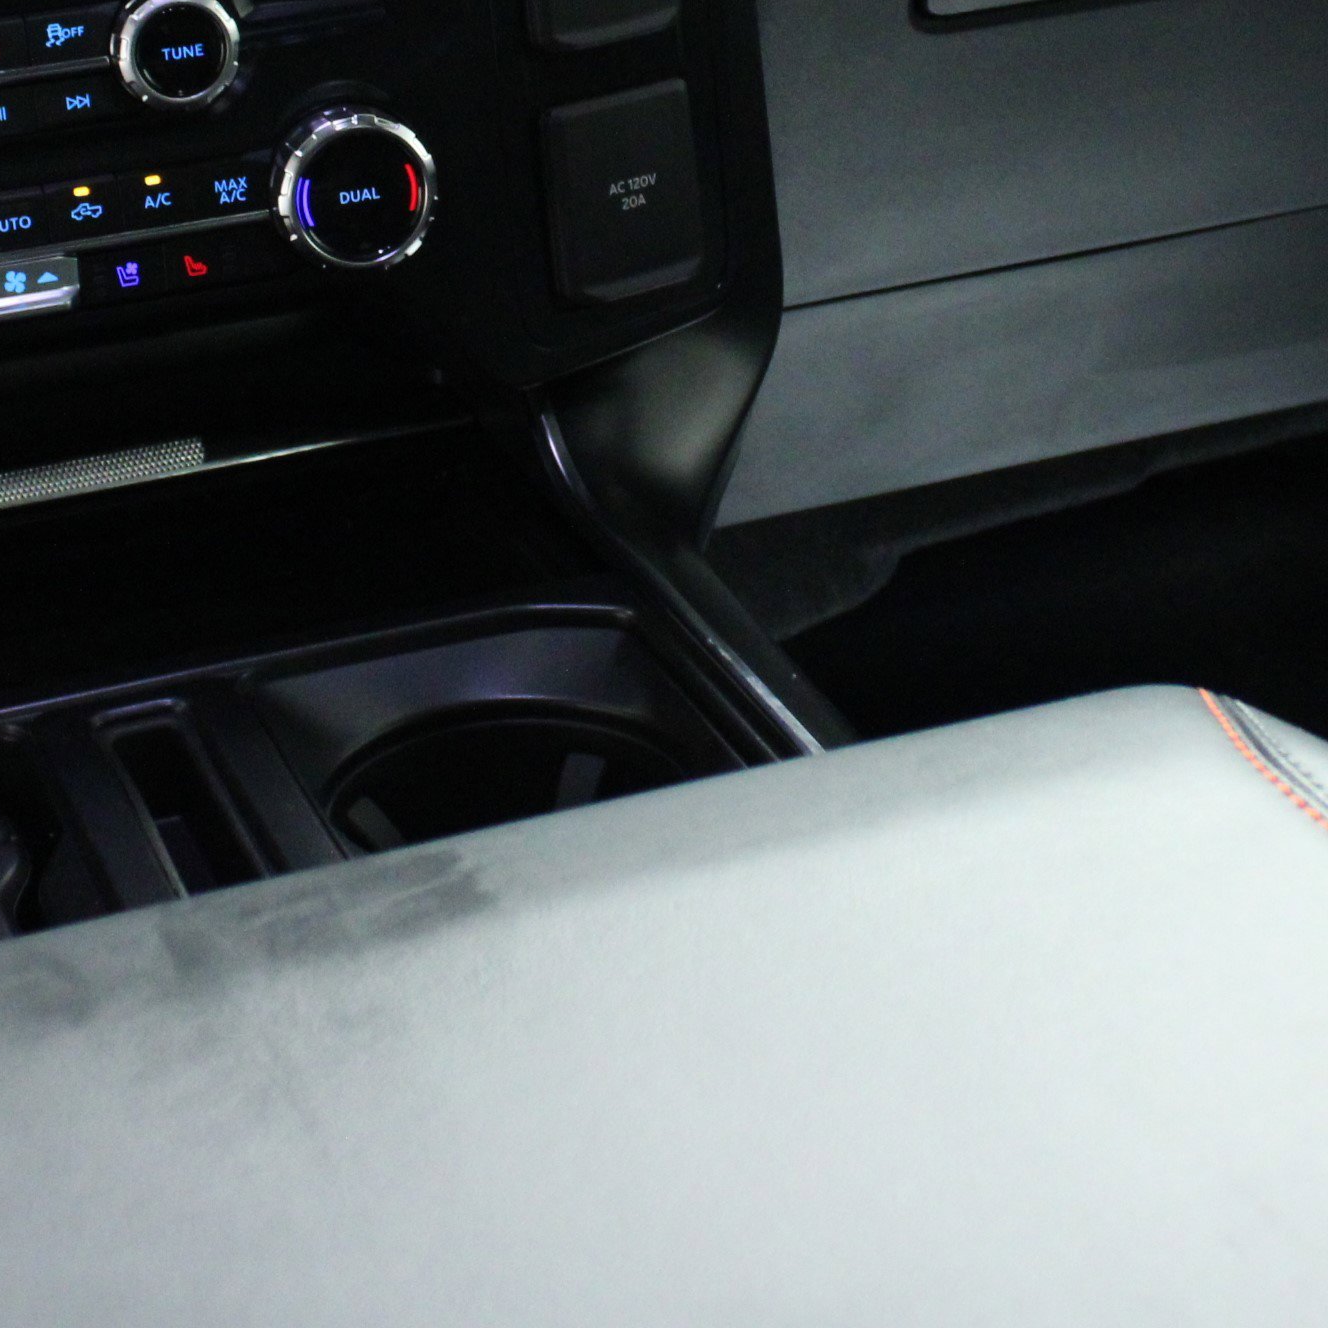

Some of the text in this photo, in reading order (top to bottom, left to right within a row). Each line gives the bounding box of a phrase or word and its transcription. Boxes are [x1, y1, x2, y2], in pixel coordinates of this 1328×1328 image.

[62, 25, 85, 39] OFF
[161, 43, 206, 62] TUNE
[214, 177, 249, 194] MAX
[609, 173, 657, 196] AC 120V
[144, 192, 172, 209] A/C
[219, 189, 248, 205] A/C
[339, 187, 381, 205] DUAL
[621, 195, 647, 211] 20A
